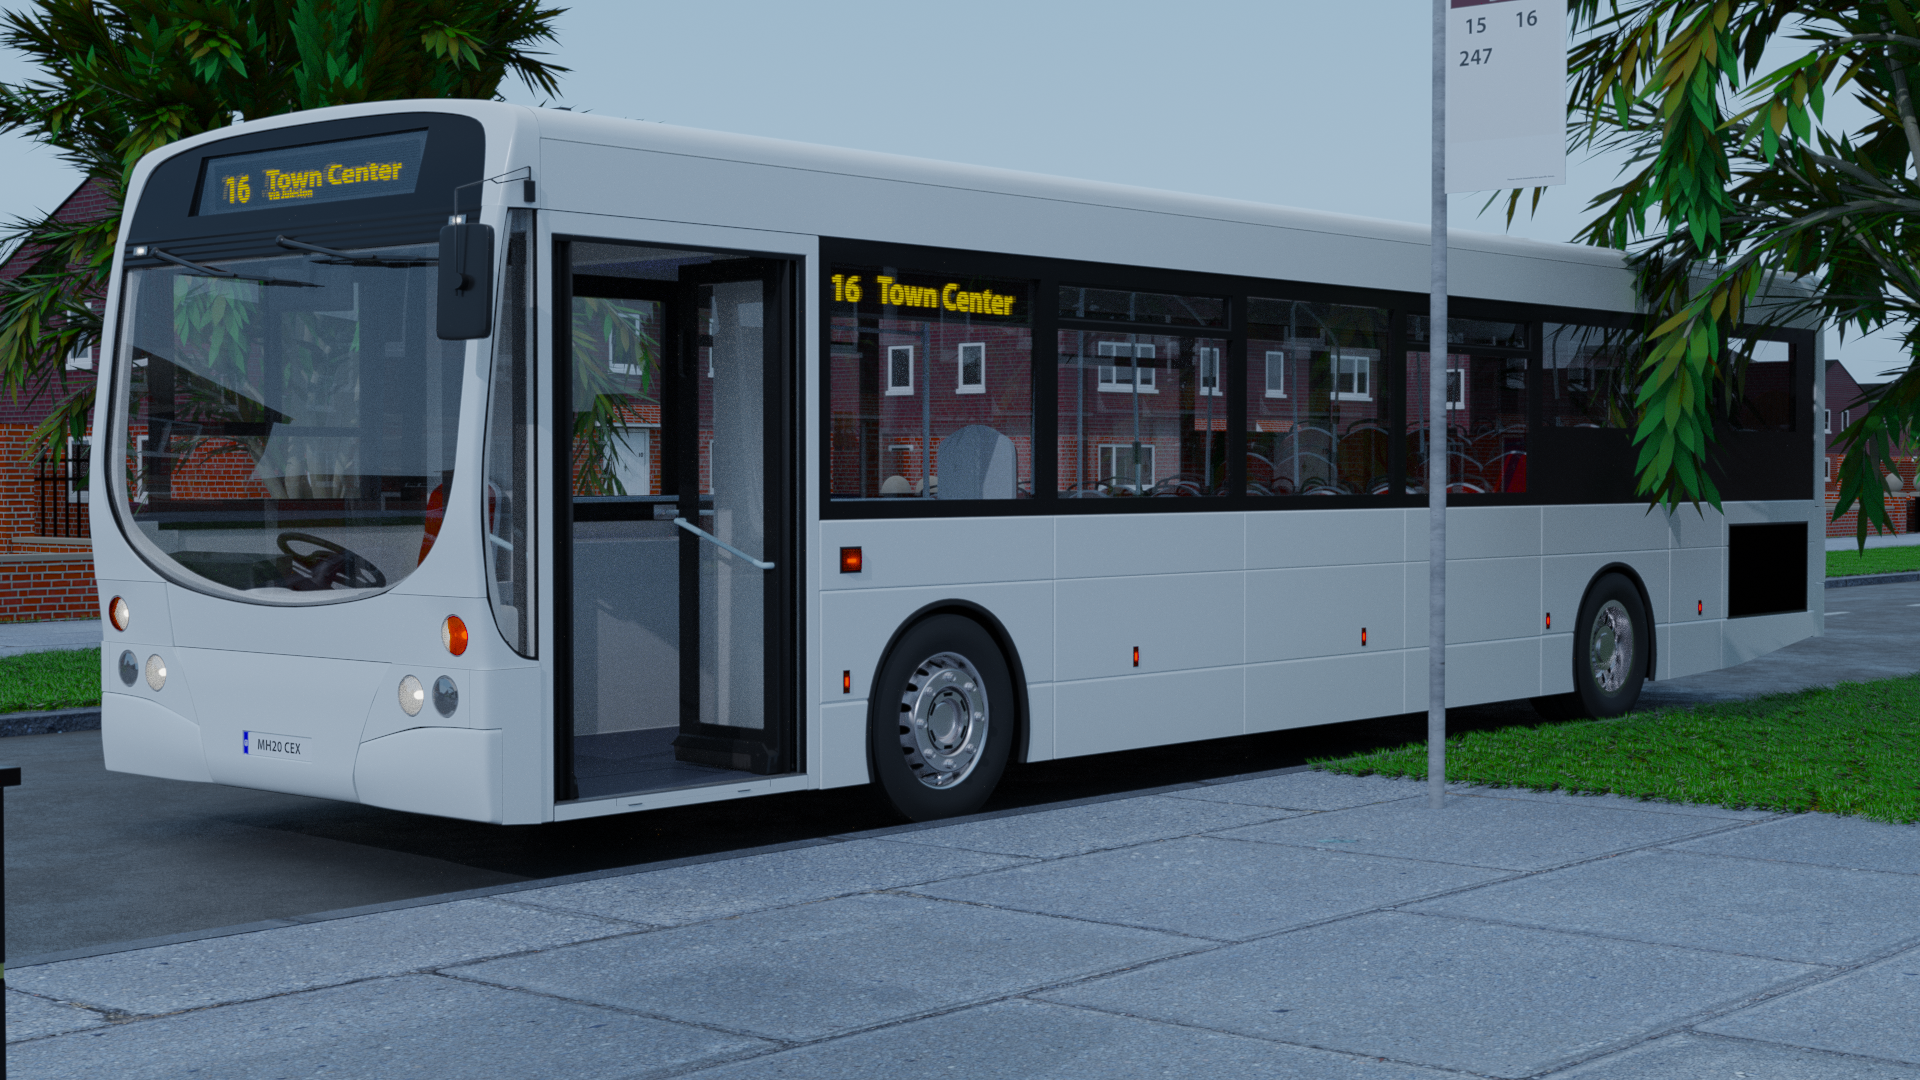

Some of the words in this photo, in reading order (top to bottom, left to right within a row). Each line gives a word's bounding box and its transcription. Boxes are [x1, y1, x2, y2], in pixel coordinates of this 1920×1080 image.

[1465, 17, 1487, 35] 15
[1515, 10, 1538, 28] 16
[1459, 48, 1493, 67] 247
[223, 174, 251, 204] 16
[265, 168, 323, 189] Town
[325, 162, 403, 186] Center
[831, 273, 863, 303] 16
[875, 275, 940, 308] Town
[941, 282, 1016, 316] Center
[257, 738, 283, 753] MH20
[284, 741, 301, 755] CEX
